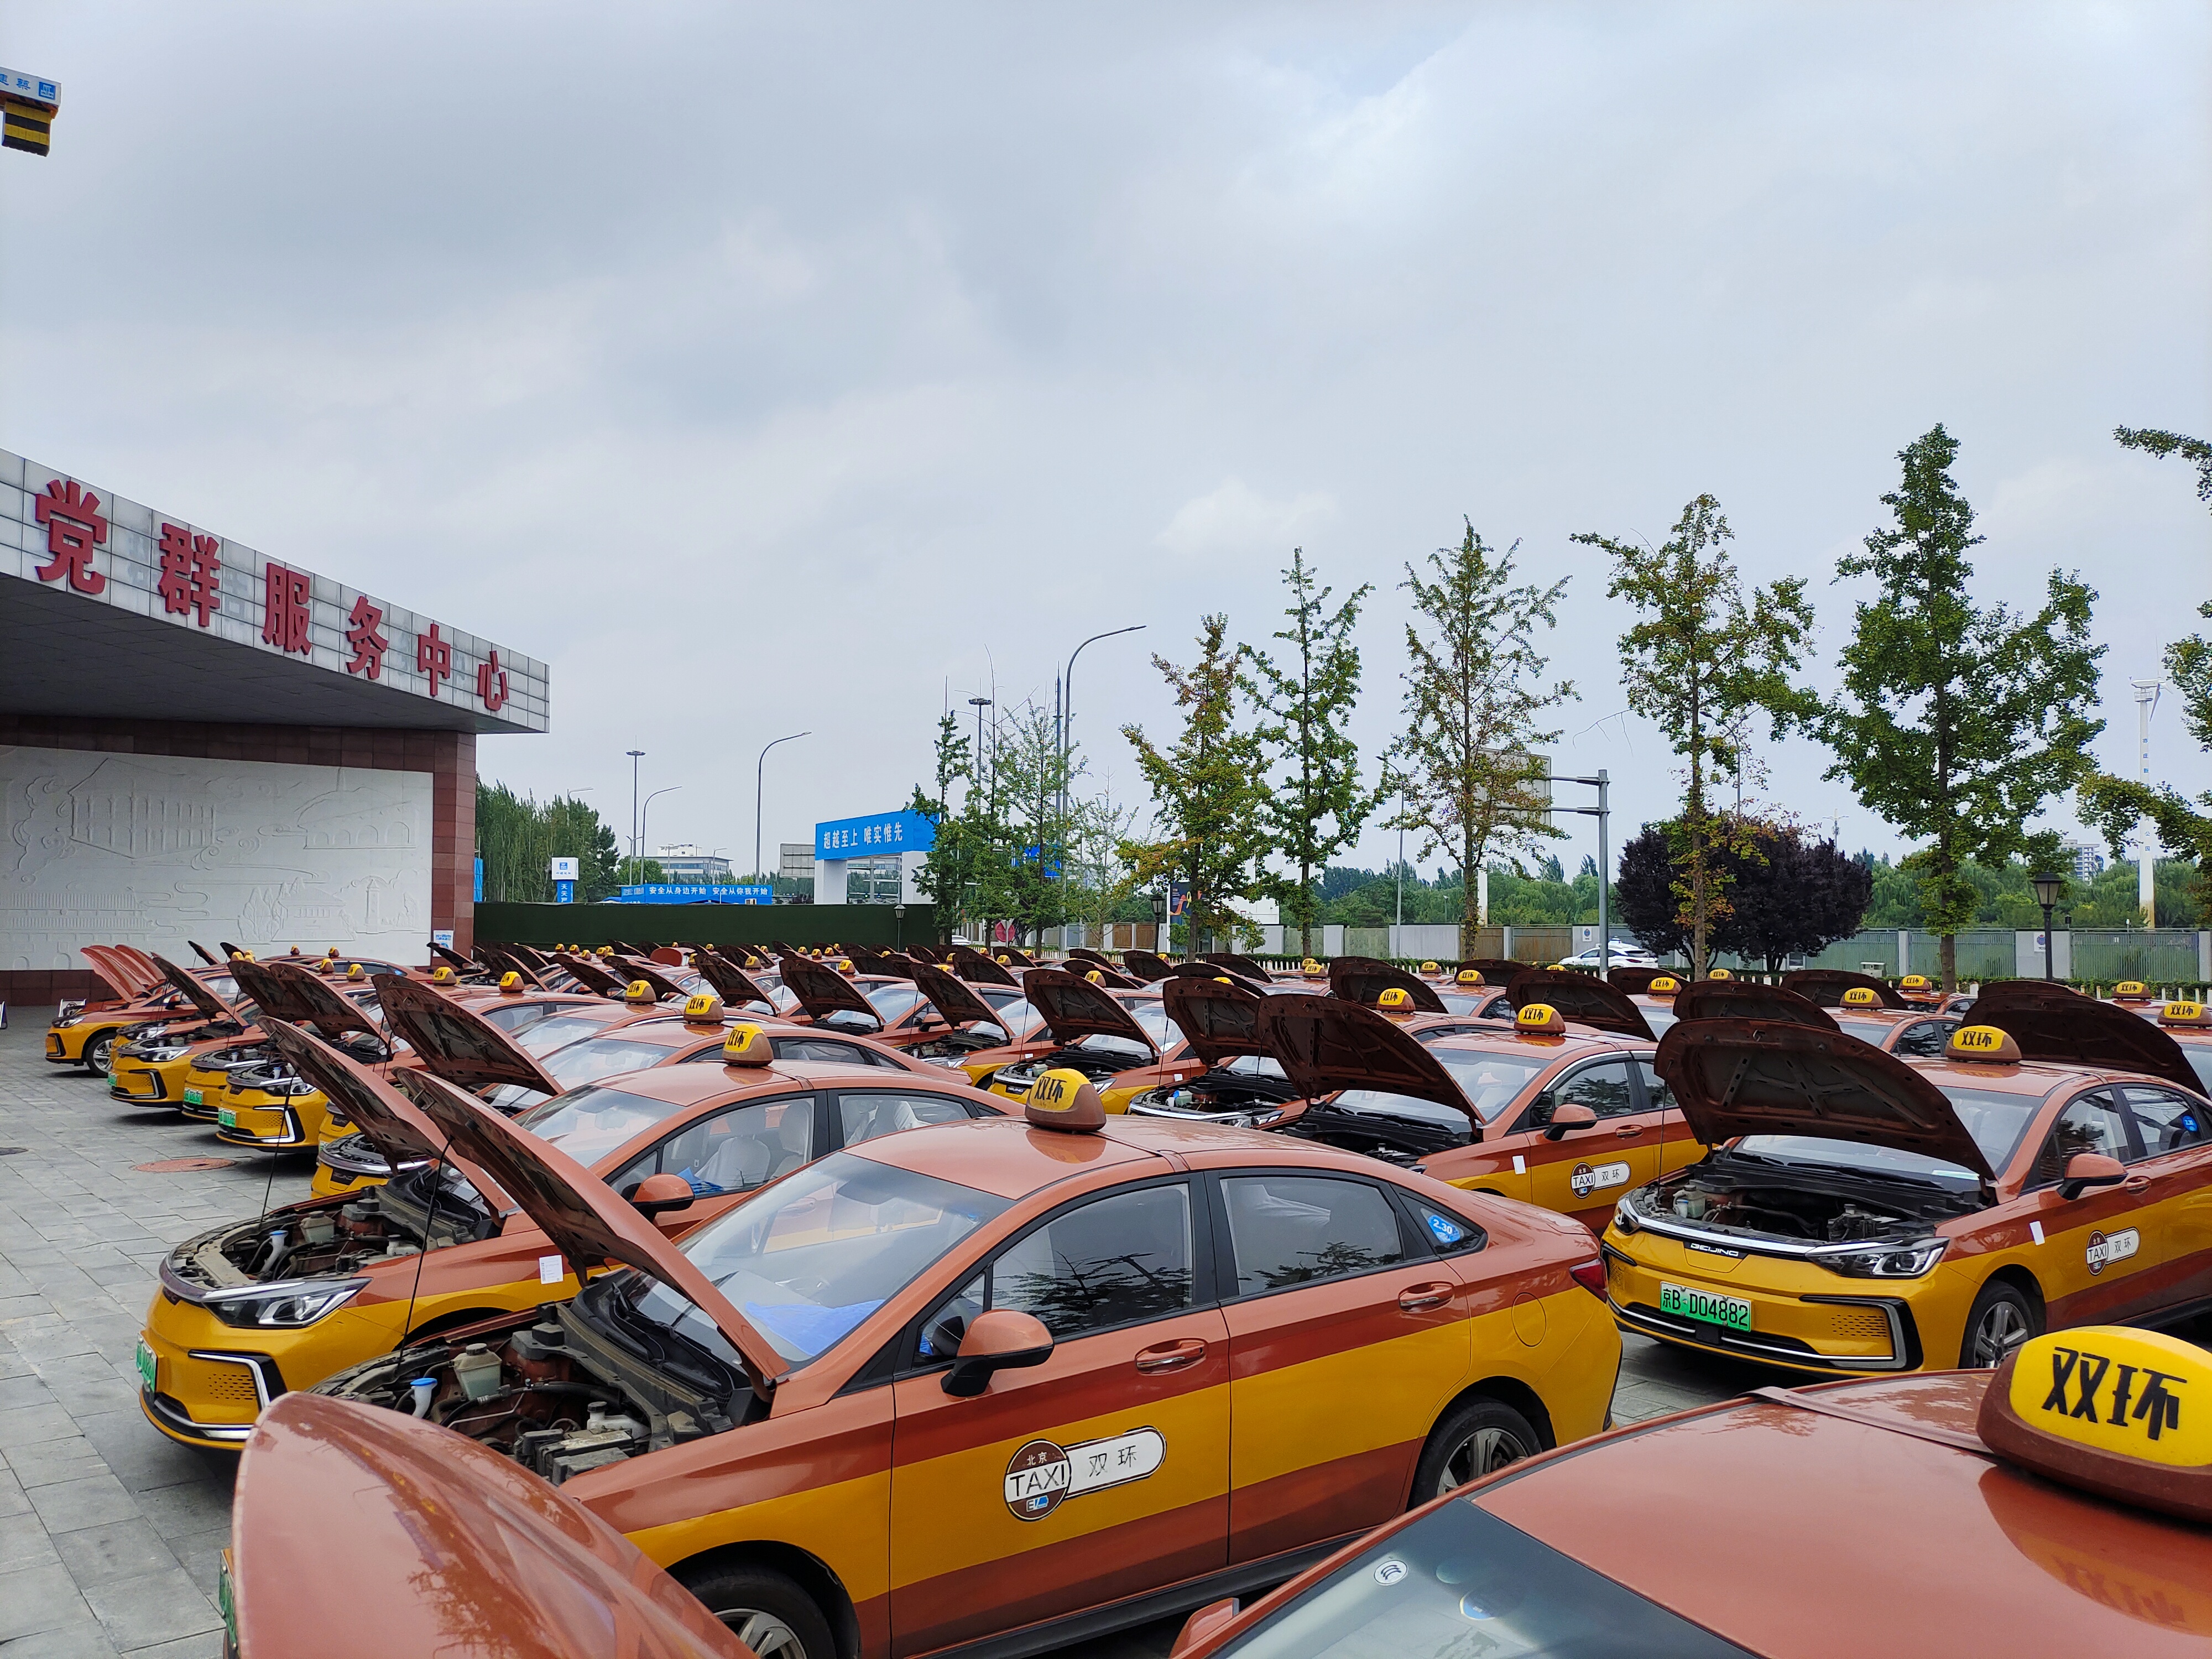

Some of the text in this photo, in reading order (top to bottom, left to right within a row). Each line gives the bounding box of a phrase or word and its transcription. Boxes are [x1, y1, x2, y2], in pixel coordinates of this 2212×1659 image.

[35, 479, 509, 711] 党群服务中心
[823, 821, 902, 849] 超越至上 唯实惟先
[649, 886, 706, 895] 安全从身边开始
[712, 886, 768, 895] 安全从你我开始
[1383, 991, 1398, 1001] 双环
[1849, 992, 1868, 1001] 双环
[689, 998, 706, 1010] 双环
[2171, 1005, 2195, 1016] 双环
[1523, 1008, 1545, 1020] 双环
[727, 1029, 747, 1047] 双环
[1961, 1031, 1994, 1047] 双环
[1035, 1076, 1067, 1103] 双环
[1573, 1174, 1593, 1187] TAXI
[1601, 1168, 1620, 1182] 双环
[1433, 1219, 1453, 1234] 2.30
[1691, 1243, 1739, 1257] BEIJING
[2088, 1245, 2106, 1261] TAXI
[2115, 1237, 2131, 1254] 双环
[2042, 1347, 2187, 1441] 双环
[1026, 1452, 1048, 1467] 北京
[1088, 1445, 1137, 1478] 双环
[1010, 1464, 1065, 1497] TAXI
